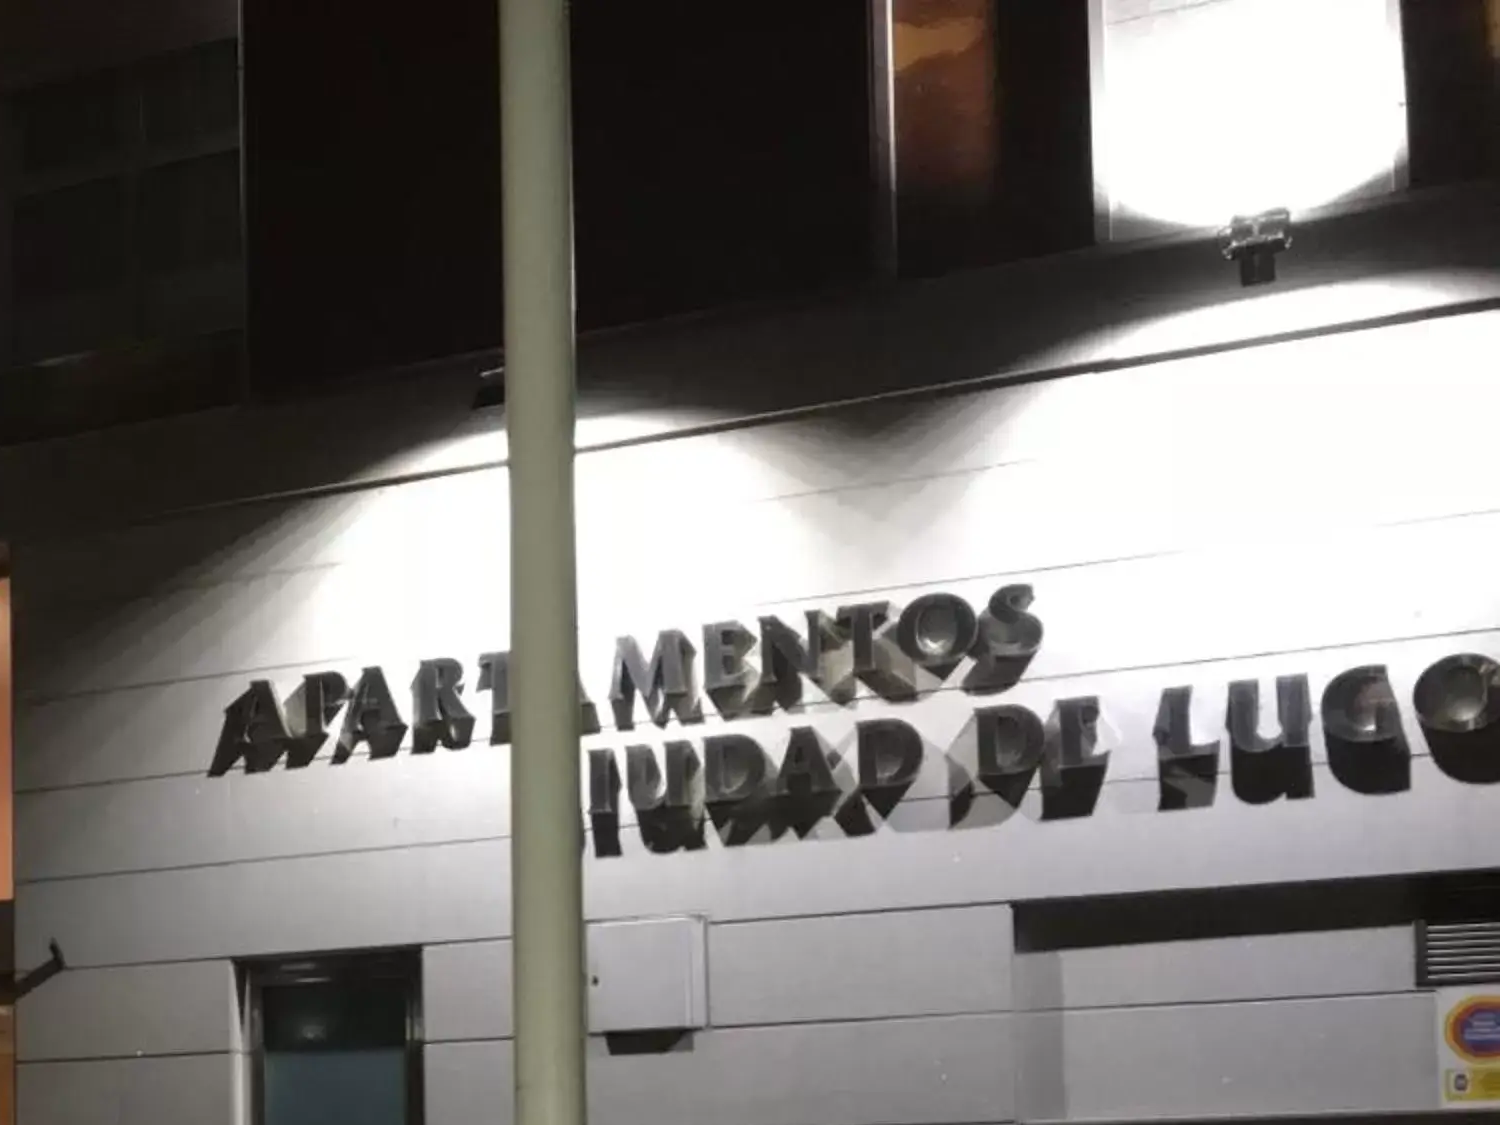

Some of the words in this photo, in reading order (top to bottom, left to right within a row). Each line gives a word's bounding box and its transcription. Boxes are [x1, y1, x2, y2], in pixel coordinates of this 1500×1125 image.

[240, 583, 1043, 745] APARTMENTOS
[579, 716, 924, 820] IUDAD
[974, 695, 1110, 775] DE
[1155, 652, 1500, 760] LUGO
